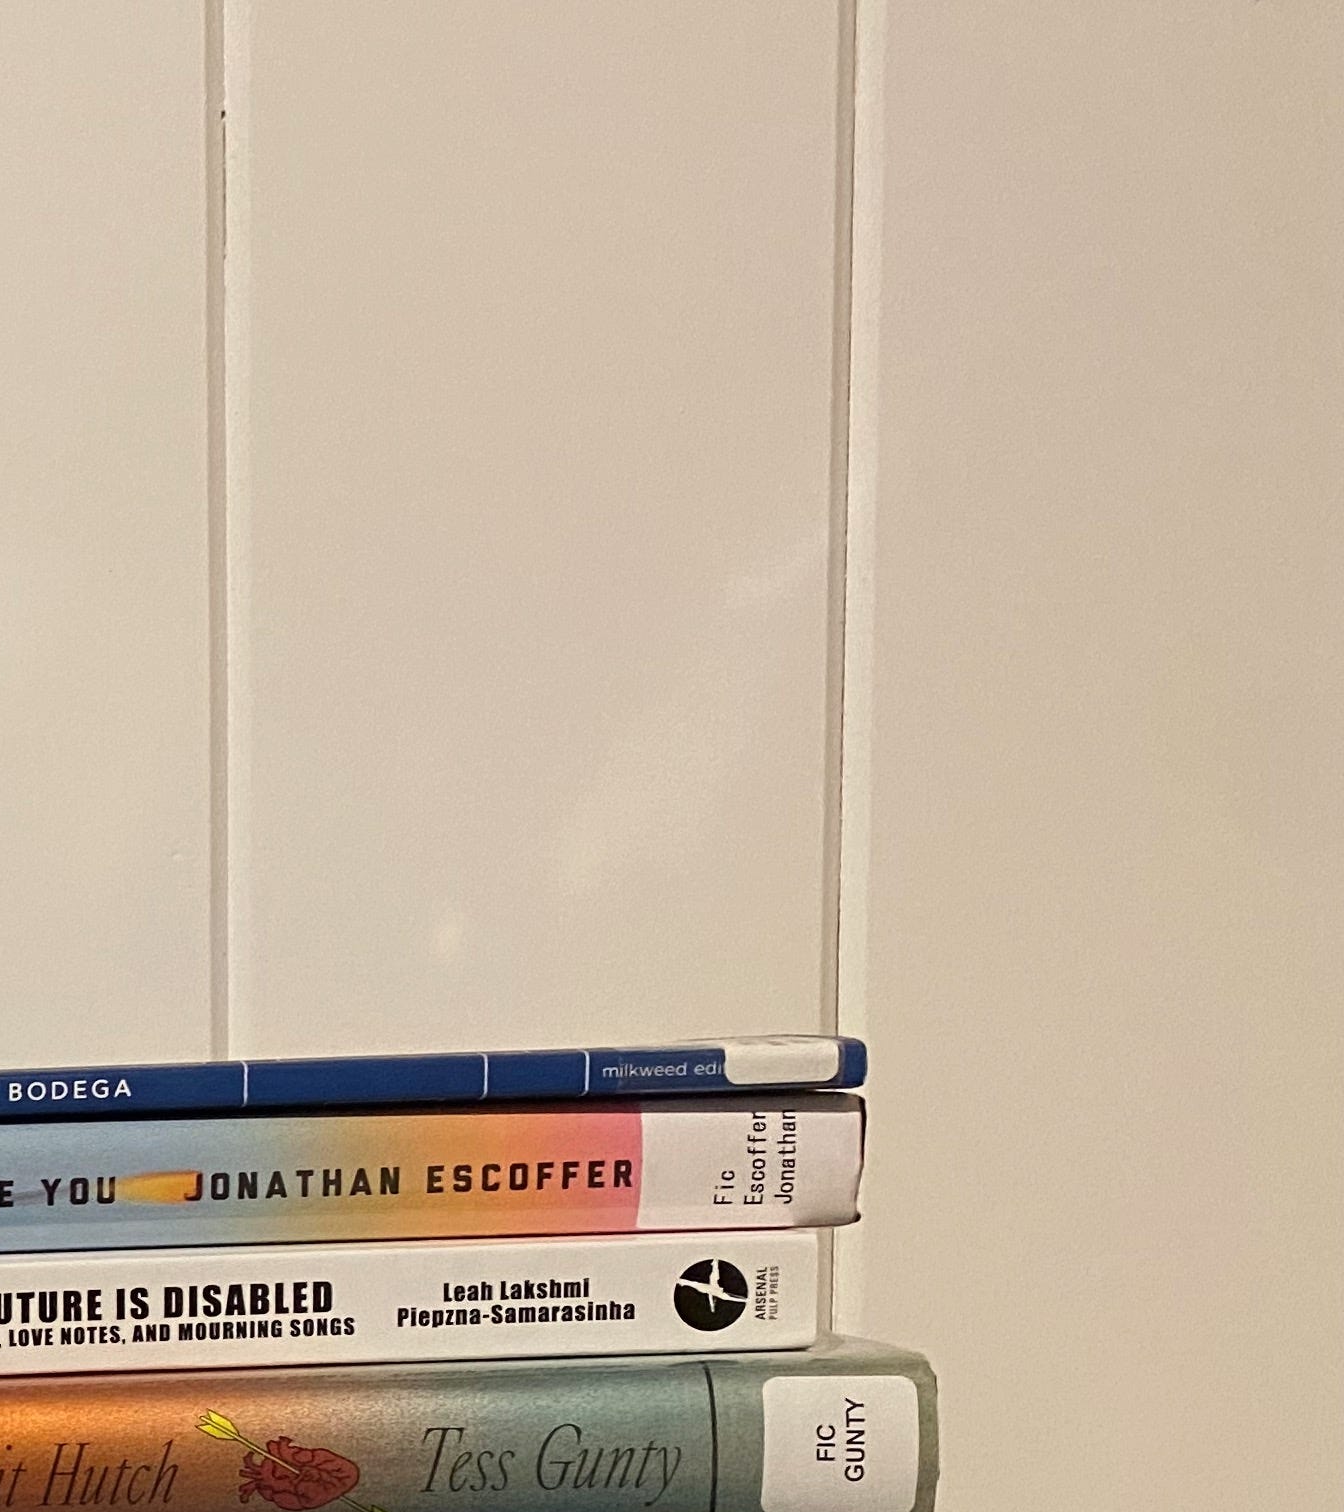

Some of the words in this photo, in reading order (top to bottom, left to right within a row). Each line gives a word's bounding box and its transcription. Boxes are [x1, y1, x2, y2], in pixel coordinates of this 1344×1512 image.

[8, 1079, 132, 1102] BODEGA
[744, 1110, 767, 1206] Escoffer
[774, 1109, 797, 1205] Jonathan
[183, 1166, 402, 1203] JONATHAN
[425, 1158, 634, 1194] ESCOFFER
[713, 1168, 735, 1206] Fic
[116, 1287, 150, 1321] IS
[164, 1281, 334, 1319] DISABLED
[442, 1281, 495, 1303] Leah
[499, 1277, 591, 1301] Lakshmi
[8, 1327, 55, 1347] LOVE
[60, 1325, 127, 1347] NOTES,
[132, 1323, 170, 1343] AND
[178, 1320, 284, 1342] MOURNING
[289, 1316, 356, 1339] SONGS
[396, 1300, 637, 1329] Piepzna-Samarasinha
[816, 1423, 837, 1463] FIC
[844, 1397, 867, 1482] GUNTY
[35, 1440, 181, 1508] Hutch
[421, 1424, 515, 1493] Tess
[535, 1422, 683, 1509] Gunty
